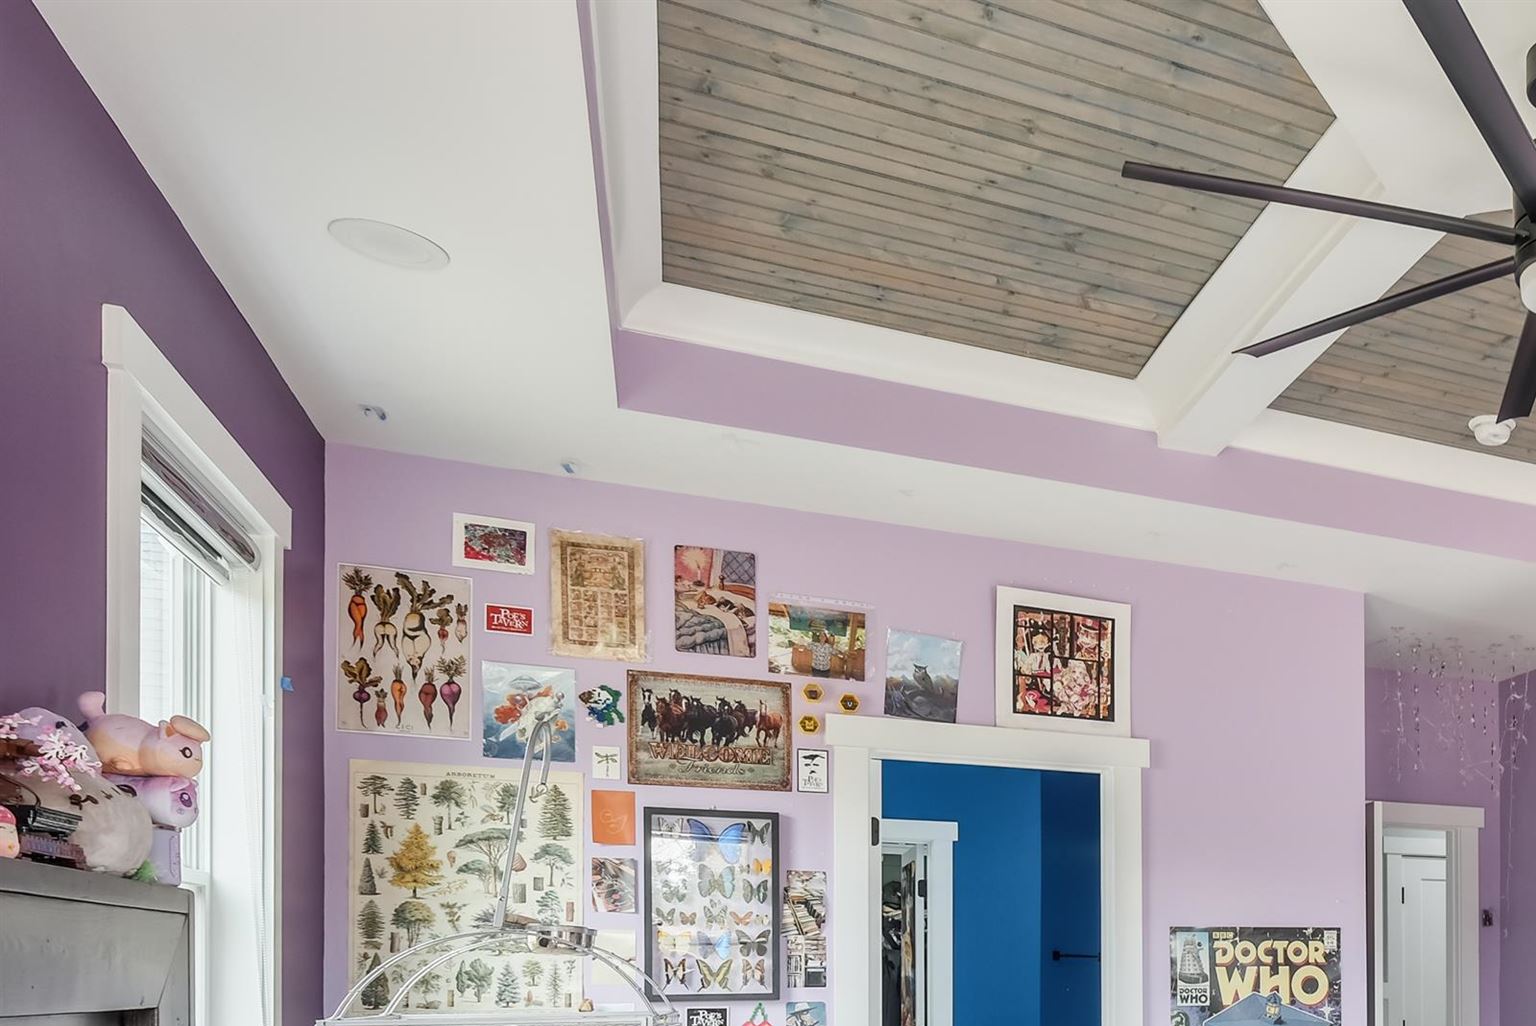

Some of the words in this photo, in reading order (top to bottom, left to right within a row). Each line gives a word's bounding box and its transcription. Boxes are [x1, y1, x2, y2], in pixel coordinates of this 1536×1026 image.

[648, 742, 771, 765] WELCOME
[677, 761, 745, 775] Friends
[1212, 940, 1328, 965] DOCTOR
[1214, 965, 1330, 1006] WHO
[1179, 994, 1208, 1004] WHO
